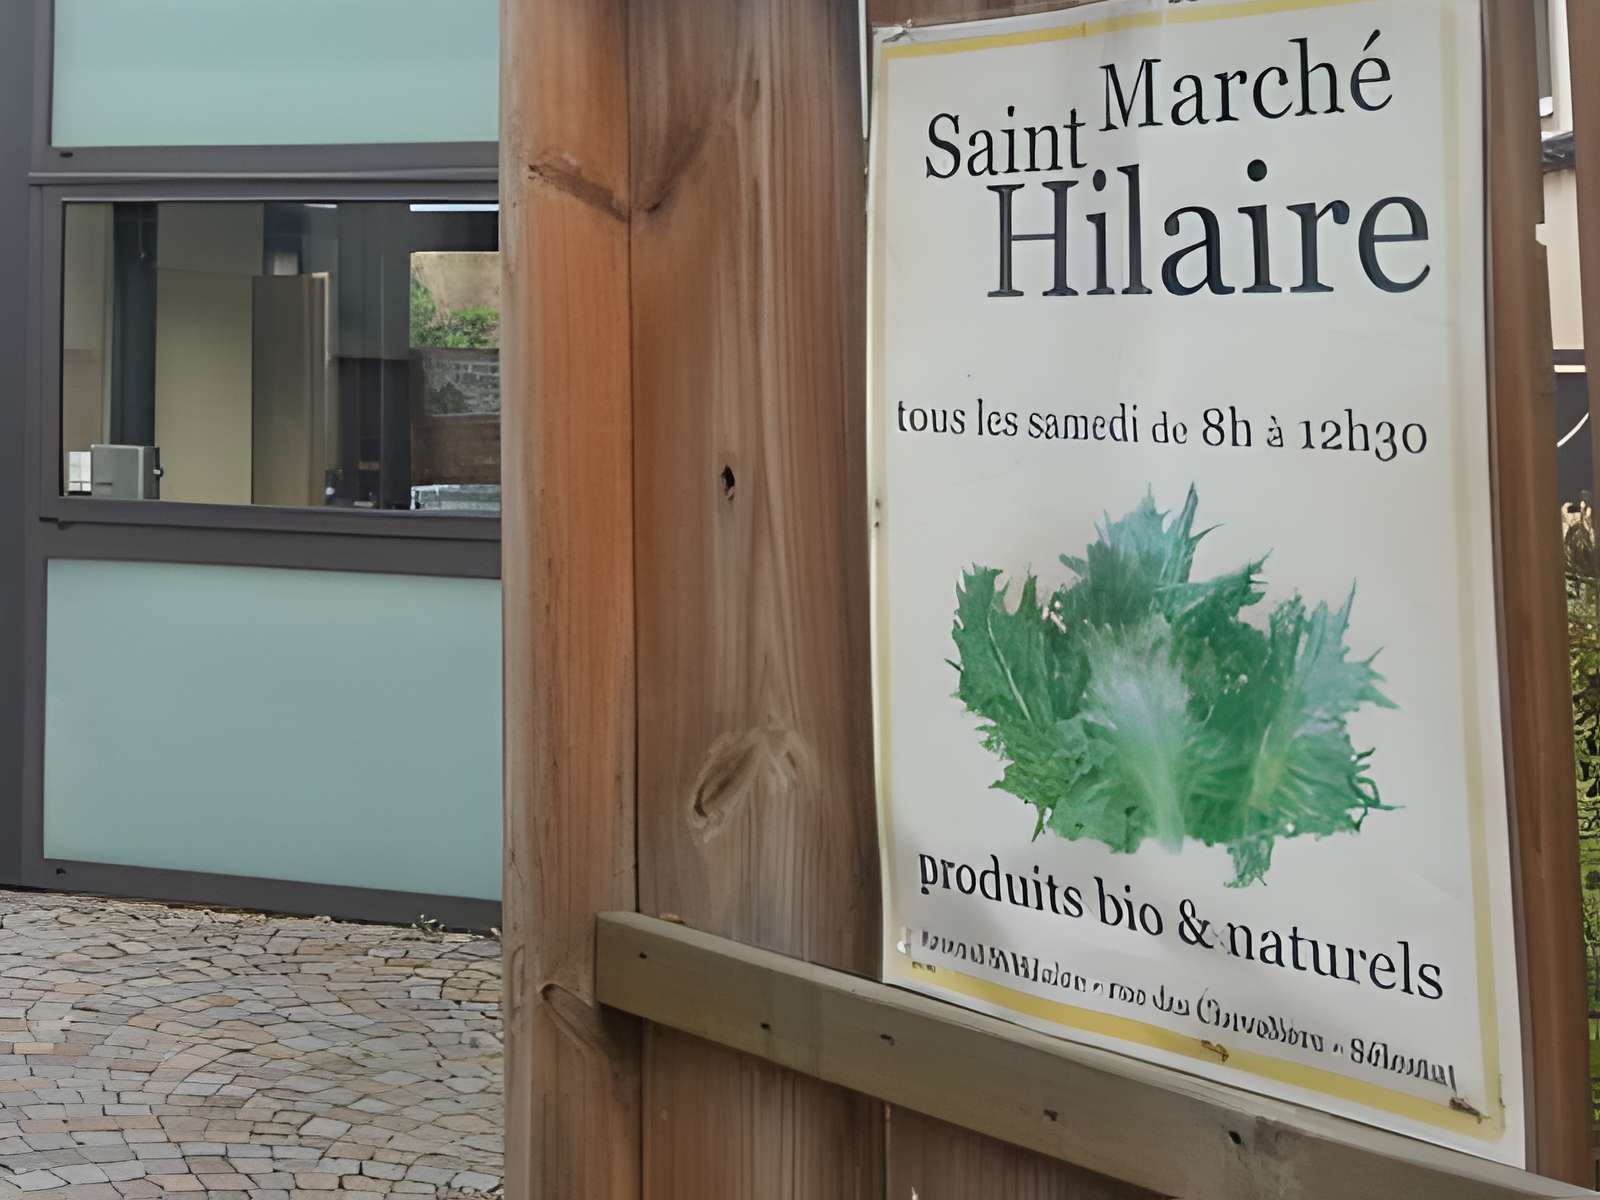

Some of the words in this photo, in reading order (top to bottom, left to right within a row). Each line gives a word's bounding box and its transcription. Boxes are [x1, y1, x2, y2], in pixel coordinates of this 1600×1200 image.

[1098, 28, 1394, 132] Marché
[925, 105, 1088, 179] Saint
[986, 158, 1431, 298] Hilaire
[897, 400, 966, 435] tous
[976, 398, 1018, 438] les
[1028, 402, 1139, 443] samedi
[1151, 410, 1188, 445] de
[1202, 405, 1253, 448] 8h
[1266, 414, 1285, 449] à
[1300, 408, 1428, 462] 12h30
[918, 852, 1084, 919] produits
[1093, 875, 1164, 936] bio
[1177, 898, 1215, 950] &
[1226, 922, 1444, 1000] naturels
